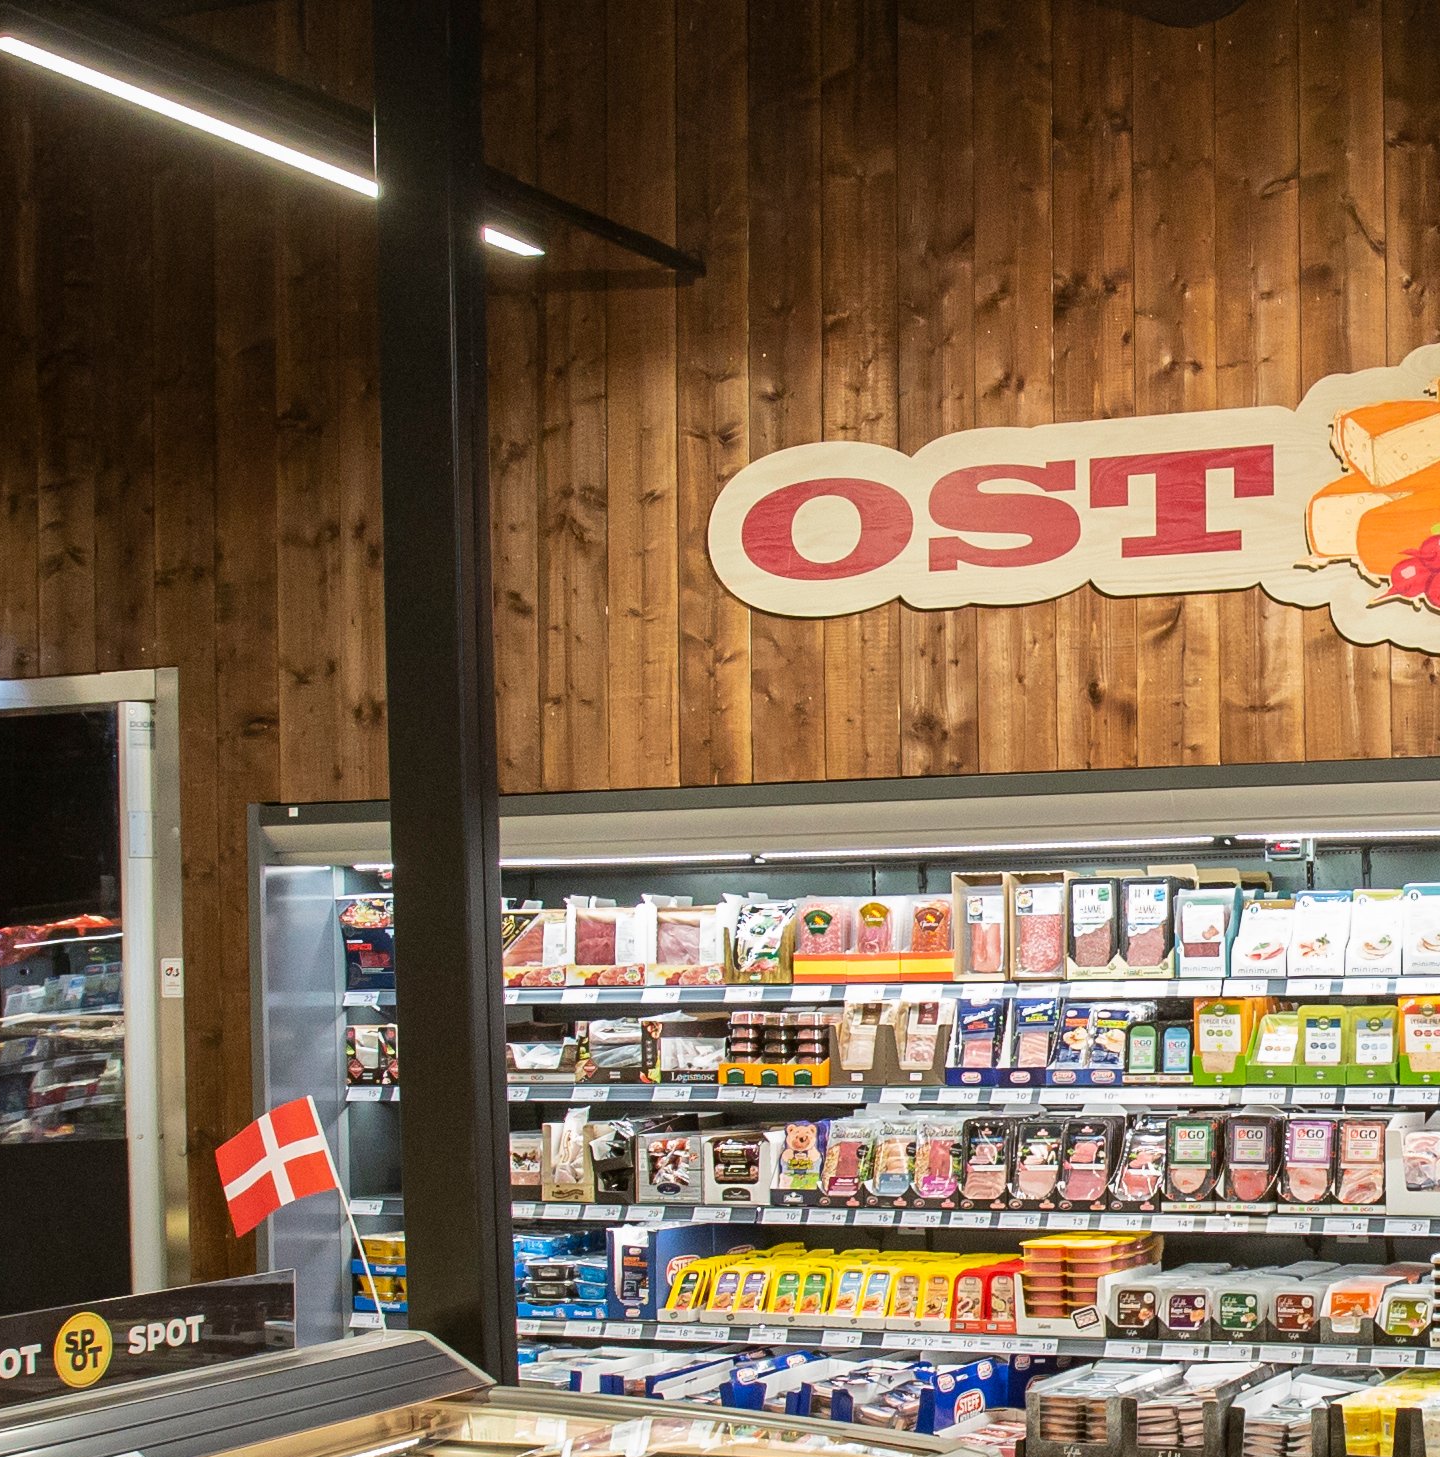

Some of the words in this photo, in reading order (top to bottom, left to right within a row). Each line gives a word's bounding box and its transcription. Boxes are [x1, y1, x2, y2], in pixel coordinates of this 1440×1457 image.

[741, 444, 1275, 582] OST
[1238, 966, 1279, 975] minimum
[513, 1090, 524, 1098] 27
[593, 1090, 603, 1098] 39
[675, 1090, 685, 1098] 34
[1178, 1129, 1206, 1141] ØGO
[1237, 1128, 1264, 1140] ØGO
[1297, 1128, 1325, 1140] ØGO
[1350, 1128, 1378, 1140] ØGO
[715, 1211, 725, 1219] 29
[127, 1315, 205, 1355] SPOT
